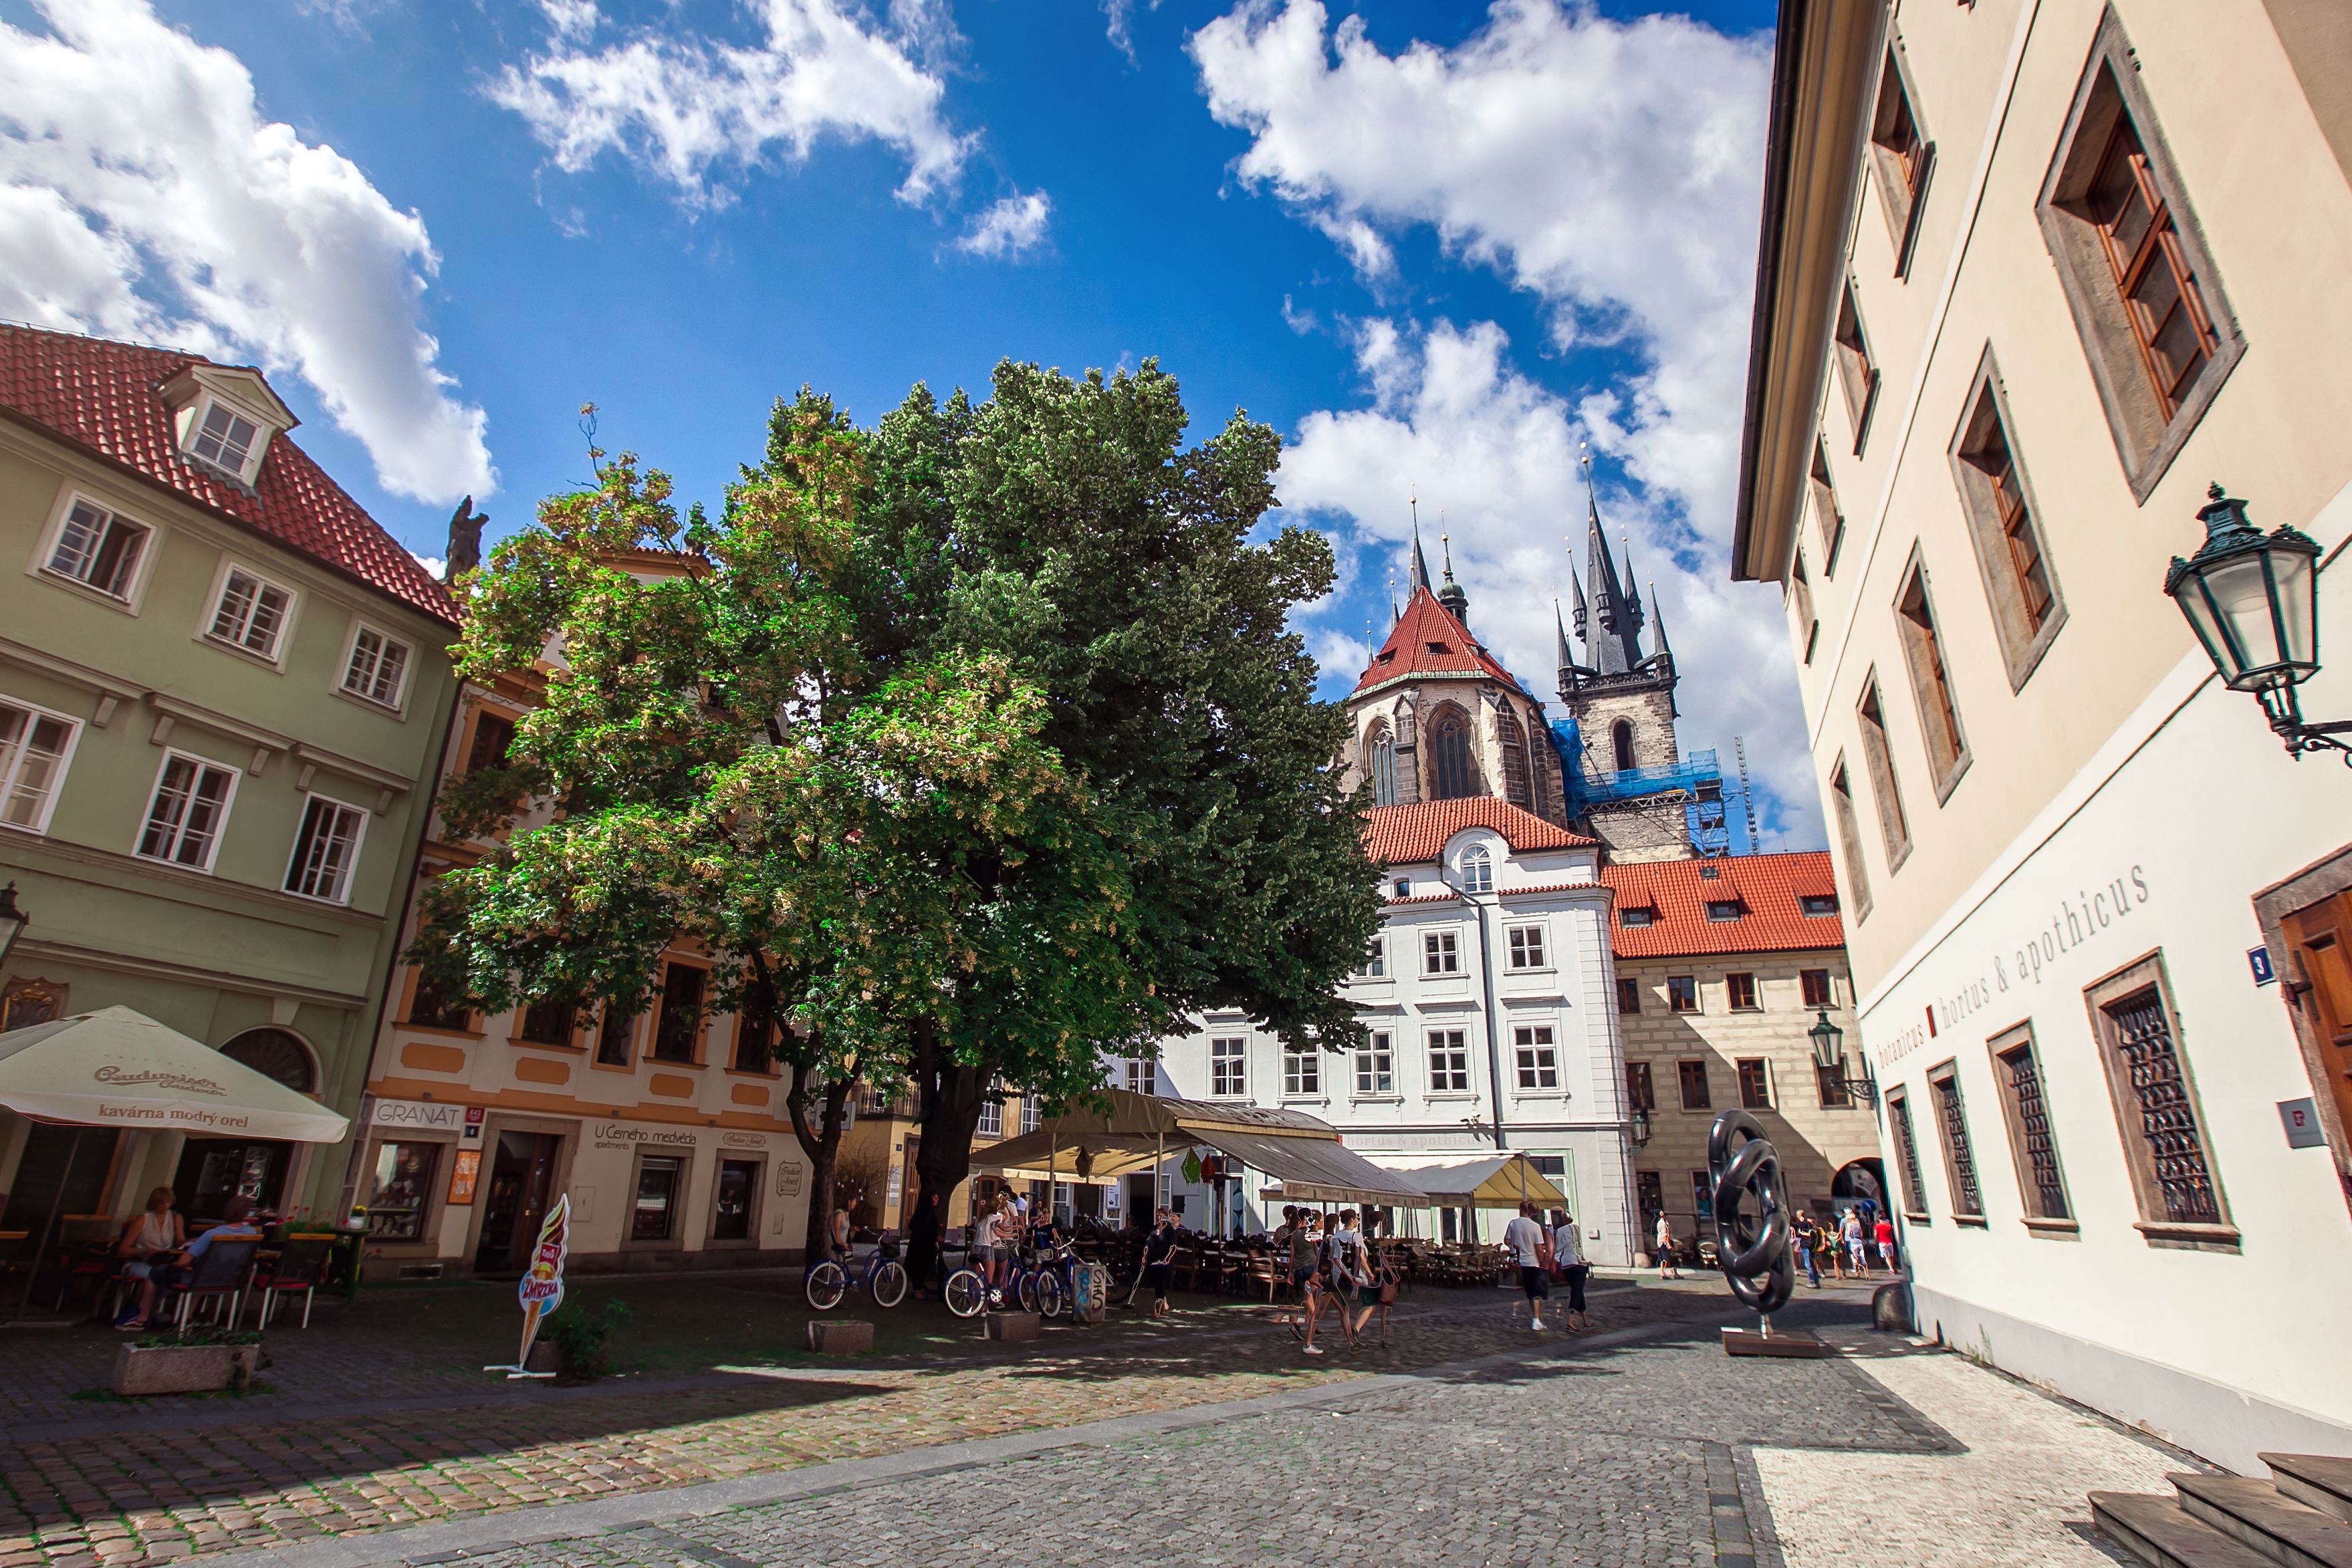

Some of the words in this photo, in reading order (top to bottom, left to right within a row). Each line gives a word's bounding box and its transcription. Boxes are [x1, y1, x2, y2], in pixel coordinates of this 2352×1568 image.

[1877, 1023, 1924, 1069] botanicus
[1939, 976, 1991, 1029] hortus
[1994, 956, 2010, 993] &
[2016, 864, 2150, 985] apothicus
[2252, 955, 2264, 976] 3
[95, 1065, 219, 1089] Budweiser
[98, 1104, 164, 1119] kavárna
[170, 1110, 217, 1126] modrý
[220, 1116, 249, 1128] orel
[377, 1103, 460, 1126] GRANÁT
[594, 1124, 605, 1138] U
[1347, 1134, 1393, 1146] hortus
[1397, 1135, 1407, 1146] &
[594, 1141, 630, 1150] apartments
